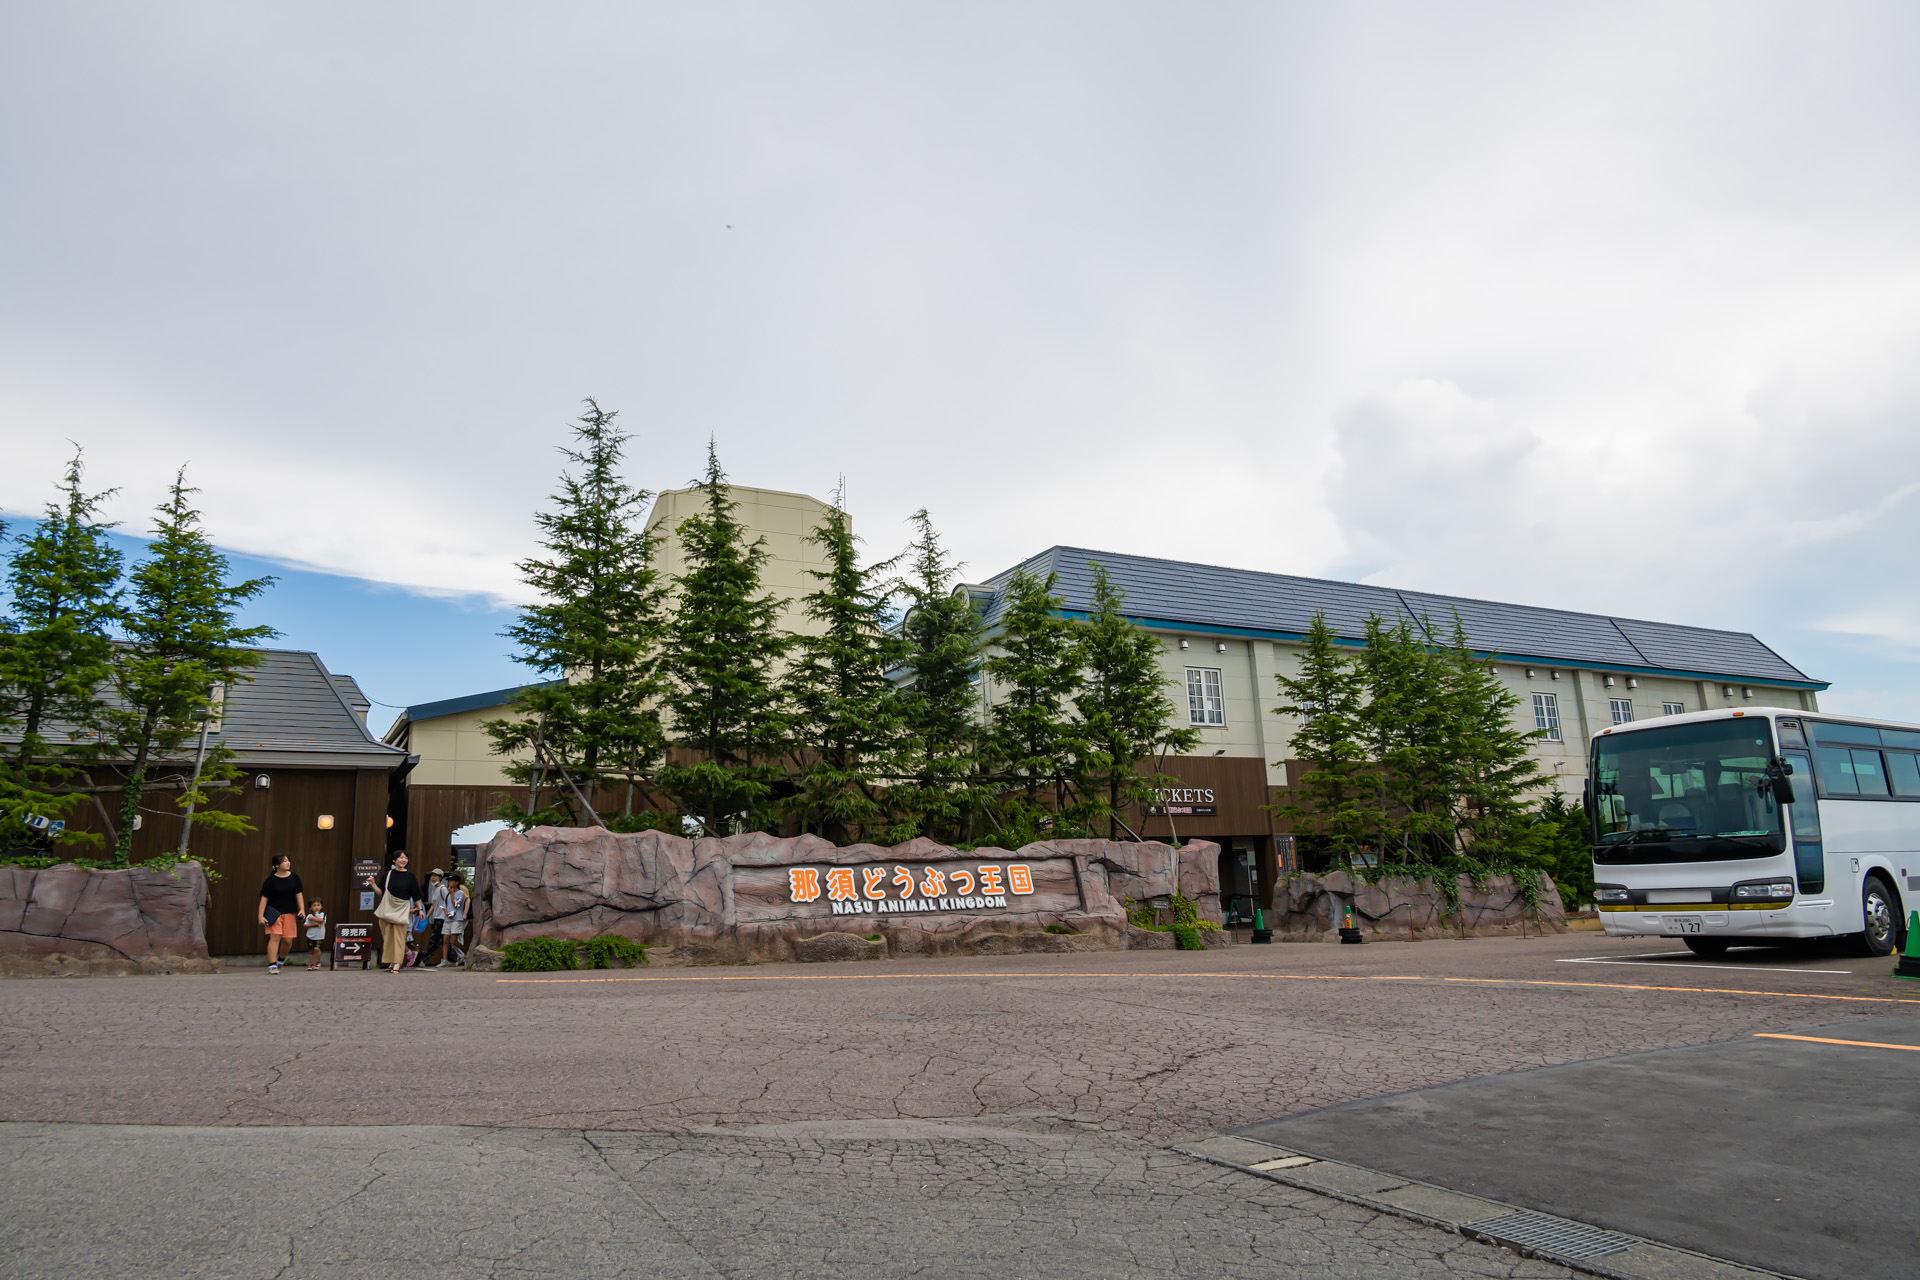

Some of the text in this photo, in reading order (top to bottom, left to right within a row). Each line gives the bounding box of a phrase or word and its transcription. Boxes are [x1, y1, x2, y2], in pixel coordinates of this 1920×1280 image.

[789, 864, 1034, 903] 那須どうぶつ王国
[832, 896, 1007, 915] NASU ANIMAL KINGDOM
[341, 928, 367, 937] 券売所
